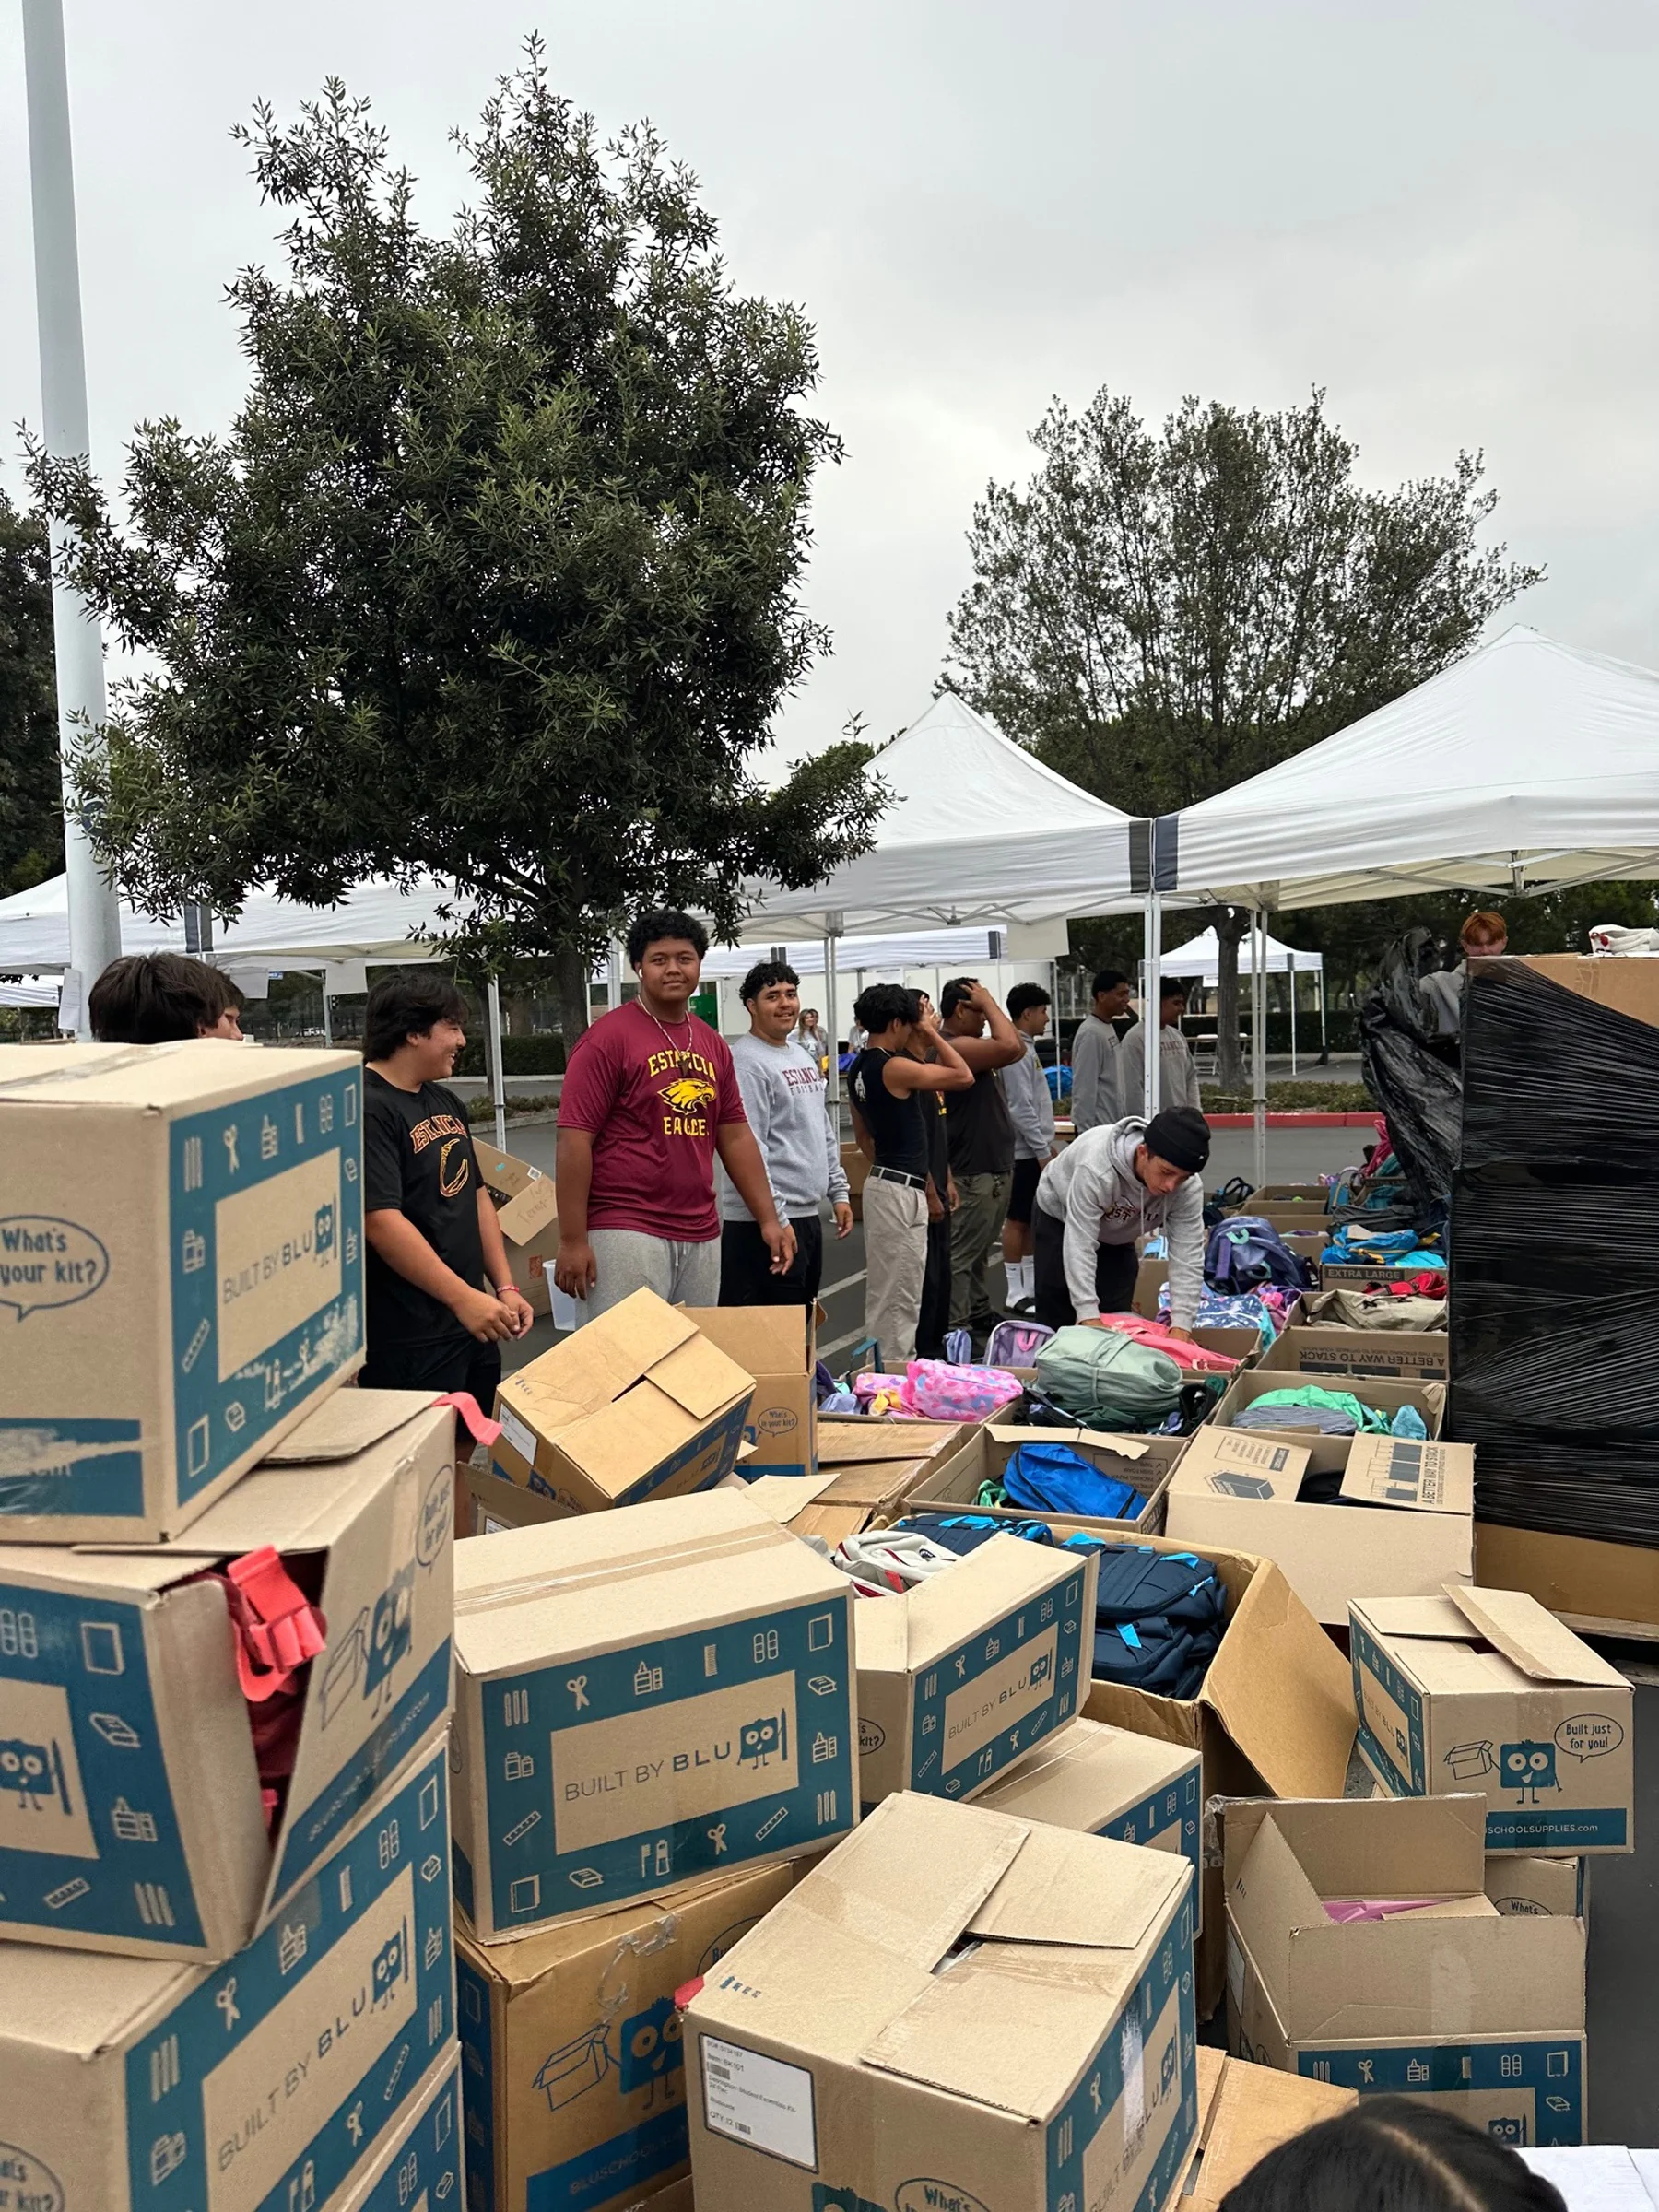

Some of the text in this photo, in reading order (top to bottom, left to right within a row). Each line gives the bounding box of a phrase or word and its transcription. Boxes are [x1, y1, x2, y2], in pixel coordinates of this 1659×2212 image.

[1, 1227, 67, 1253] What's
[55, 1258, 97, 1284] kit?
[223, 1262, 260, 1305] BUILT
[282, 1230, 312, 1266] BLU
[1327, 1268, 1401, 1280] EXTRA LARGE
[1300, 1350, 1446, 1367] A BETTER WAY TO STACK
[1422, 1478, 1436, 1500] BETTER
[947, 1676, 1027, 1740] BUILT BY BLU
[1566, 1724, 1612, 1735] Built just
[1570, 1737, 1609, 1750] for you!
[564, 1740, 731, 1802] BUILT BY BLU
[1511, 1900, 1538, 1915] What's
[218, 1987, 366, 2171] BUILT BY BLU
